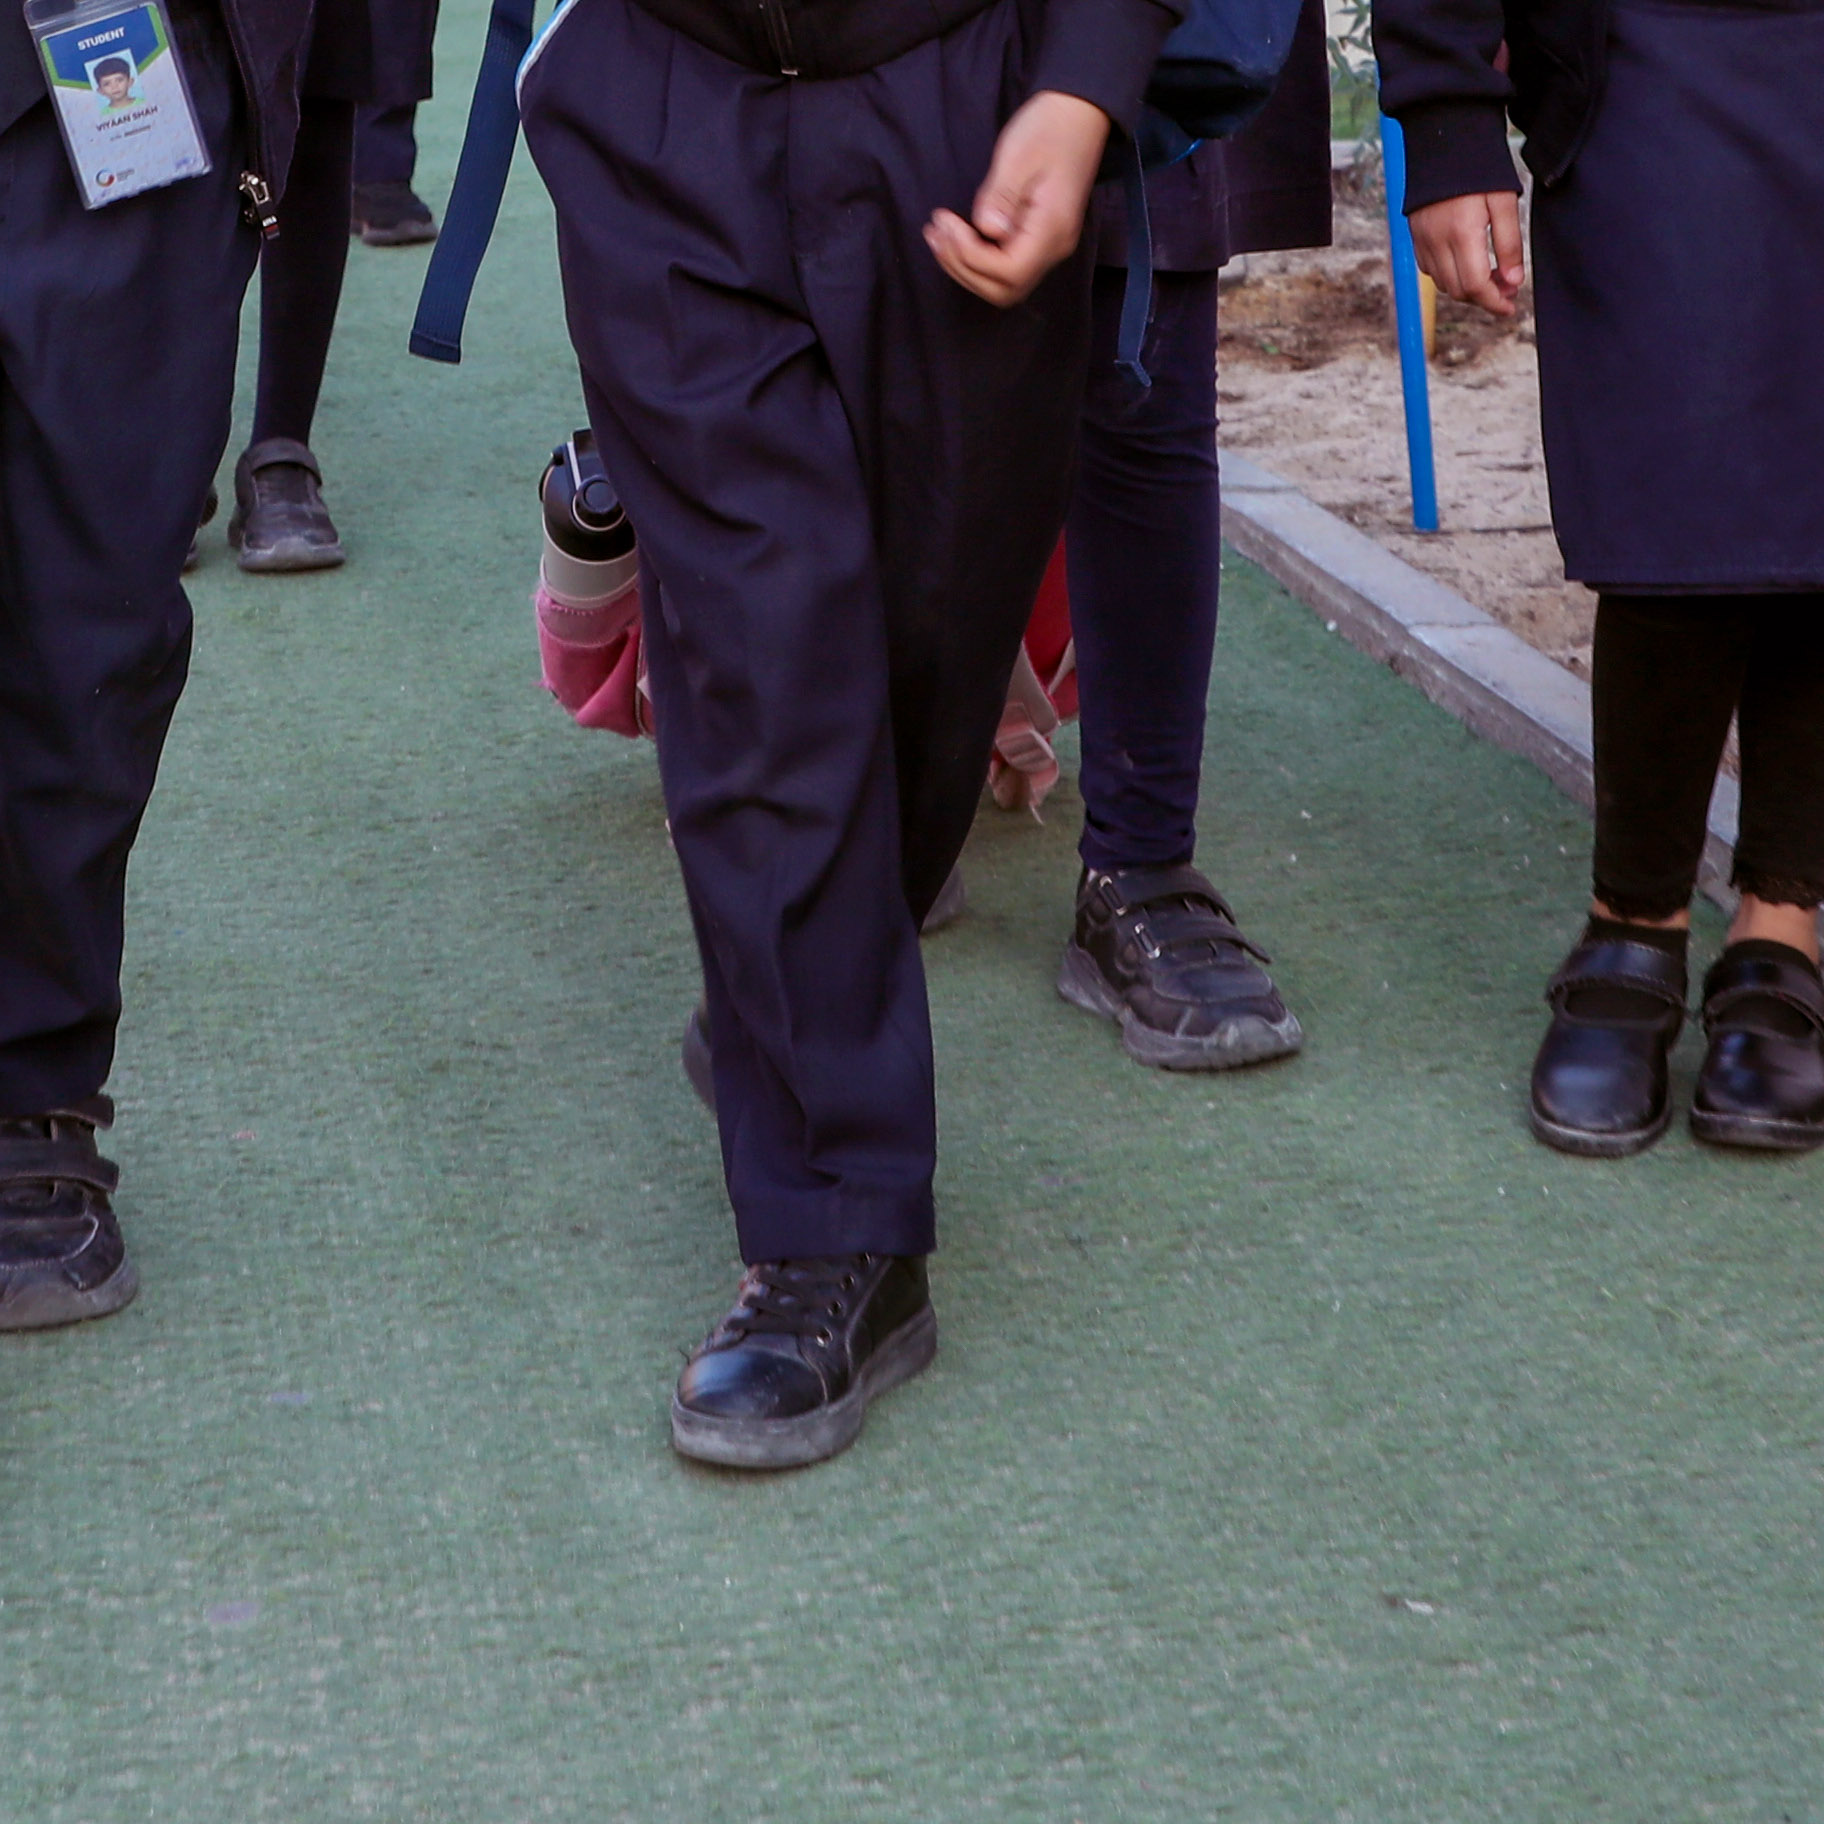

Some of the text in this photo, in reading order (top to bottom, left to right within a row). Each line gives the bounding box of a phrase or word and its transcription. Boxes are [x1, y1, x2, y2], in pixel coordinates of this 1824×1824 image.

[78, 26, 125, 51] STUDENT
[96, 105, 158, 132] VIYAAN SHAH
